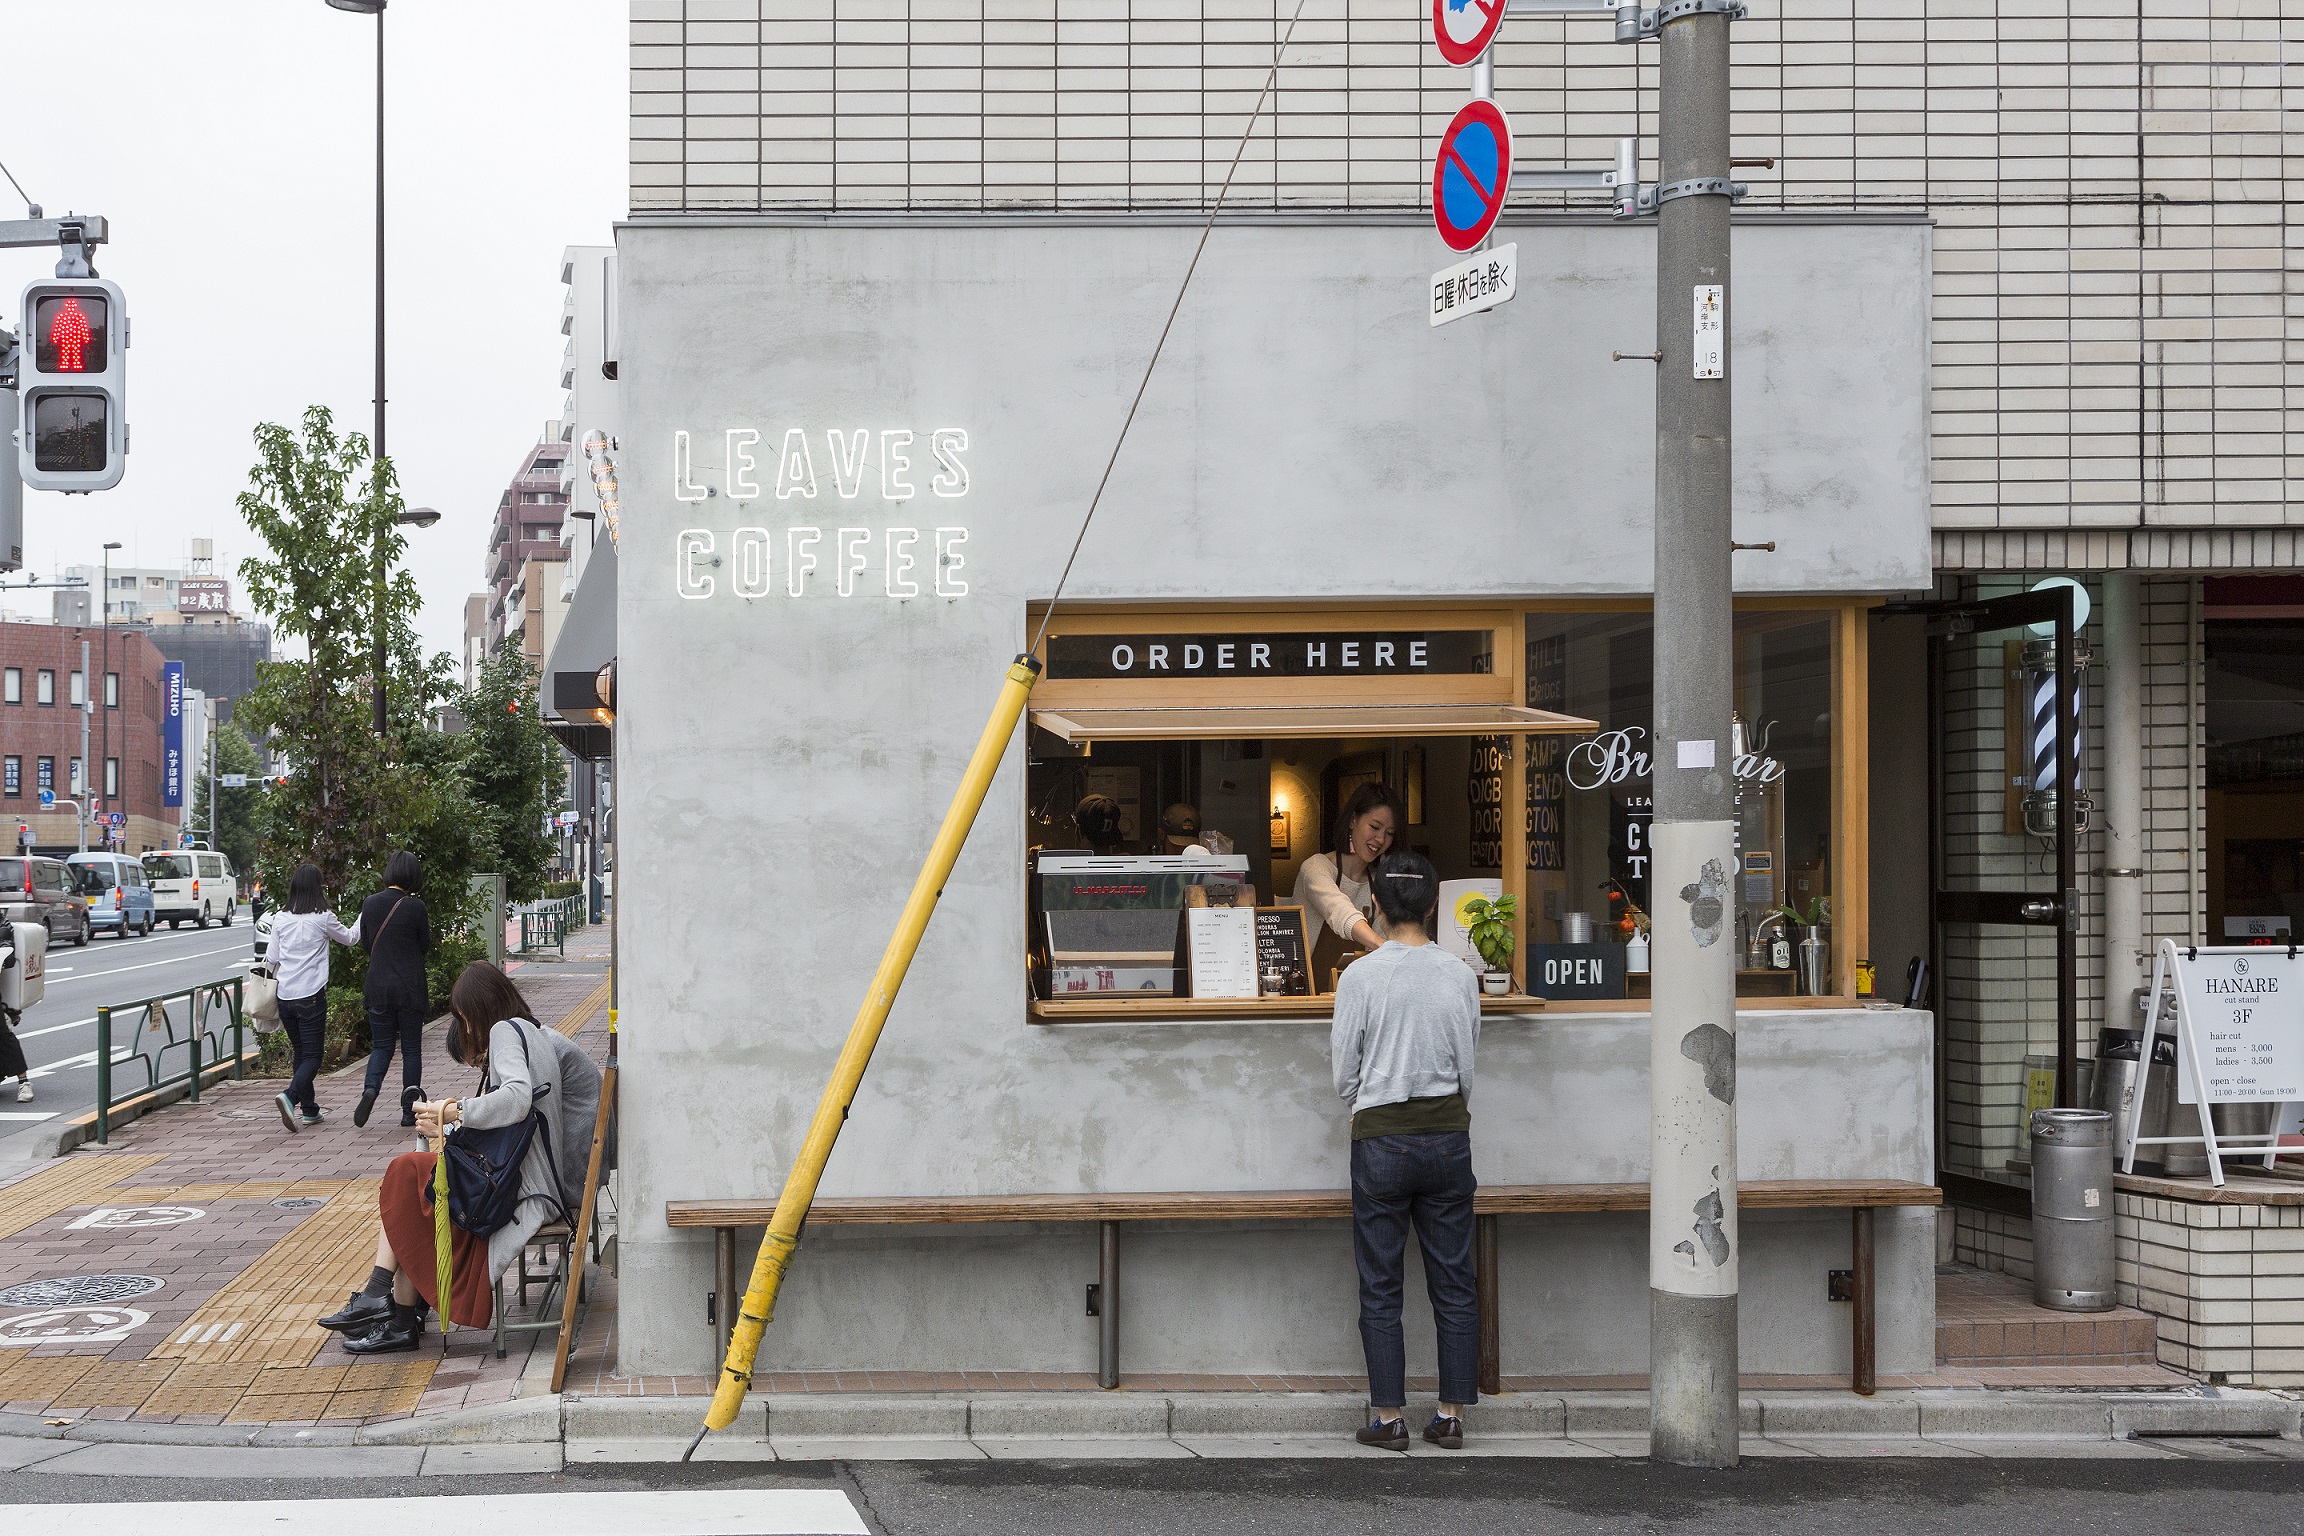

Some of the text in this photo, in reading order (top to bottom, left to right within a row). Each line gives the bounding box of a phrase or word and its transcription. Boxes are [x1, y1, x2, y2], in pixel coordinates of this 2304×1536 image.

[675, 428, 970, 501] LEAVES
[676, 527, 969, 599] COFFEE
[1112, 641, 1428, 671] ORDER HERE
[1530, 638, 1562, 671] HILL
[170, 672, 180, 717] MIZUHO
[1566, 726, 1653, 790] Br
[168, 749, 178, 796] みずほ銀行
[1470, 777, 1501, 803] DIGB
[1627, 797, 1653, 806] LEA
[112, 815, 118, 823] 6
[1257, 915, 1280, 923] PRESSO
[1545, 959, 1602, 985] OPEN
[2205, 977, 2279, 994] HANARE
[2224, 995, 2260, 1004] cut stand
[2233, 1008, 2253, 1024] 3F
[2209, 1031, 2241, 1041] hair cut
[2215, 1045, 2237, 1053] mens
[2251, 1043, 2273, 1053] 3,000
[2215, 1056, 2240, 1066] ladies
[2251, 1056, 2273, 1066] 3,500
[2210, 1077, 2230, 1087] open
[2236, 1075, 2257, 1085] close
